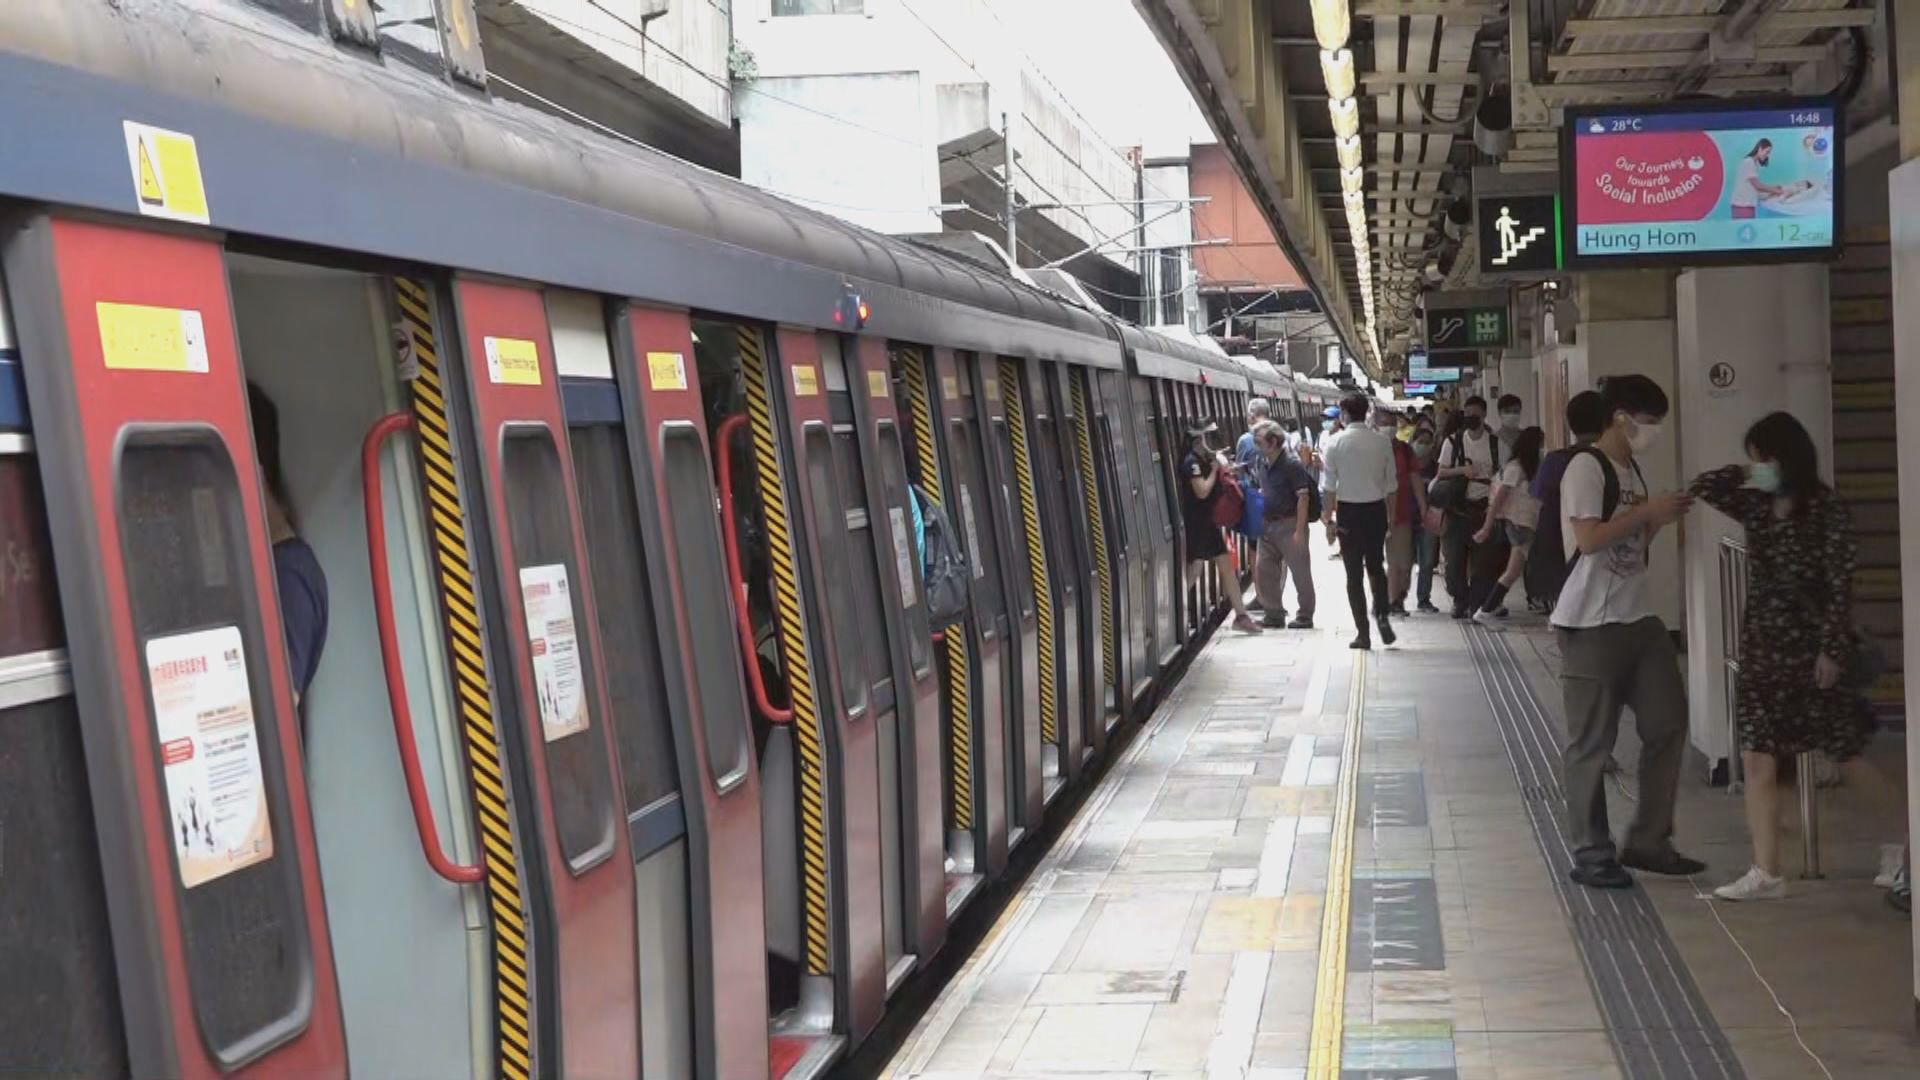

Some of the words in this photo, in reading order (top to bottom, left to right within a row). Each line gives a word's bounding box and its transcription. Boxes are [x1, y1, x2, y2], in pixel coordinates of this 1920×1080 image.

[1611, 118, 1643, 131] 28°C
[1790, 111, 1821, 125] 14:48
[1616, 156, 1636, 171] Our
[1638, 158, 1685, 173] Journey
[1627, 174, 1671, 187] towards
[1595, 172, 1637, 204] Social
[1643, 174, 1703, 205] Inclusion
[1585, 231, 1641, 251] Hung
[1648, 228, 1696, 246] Hom
